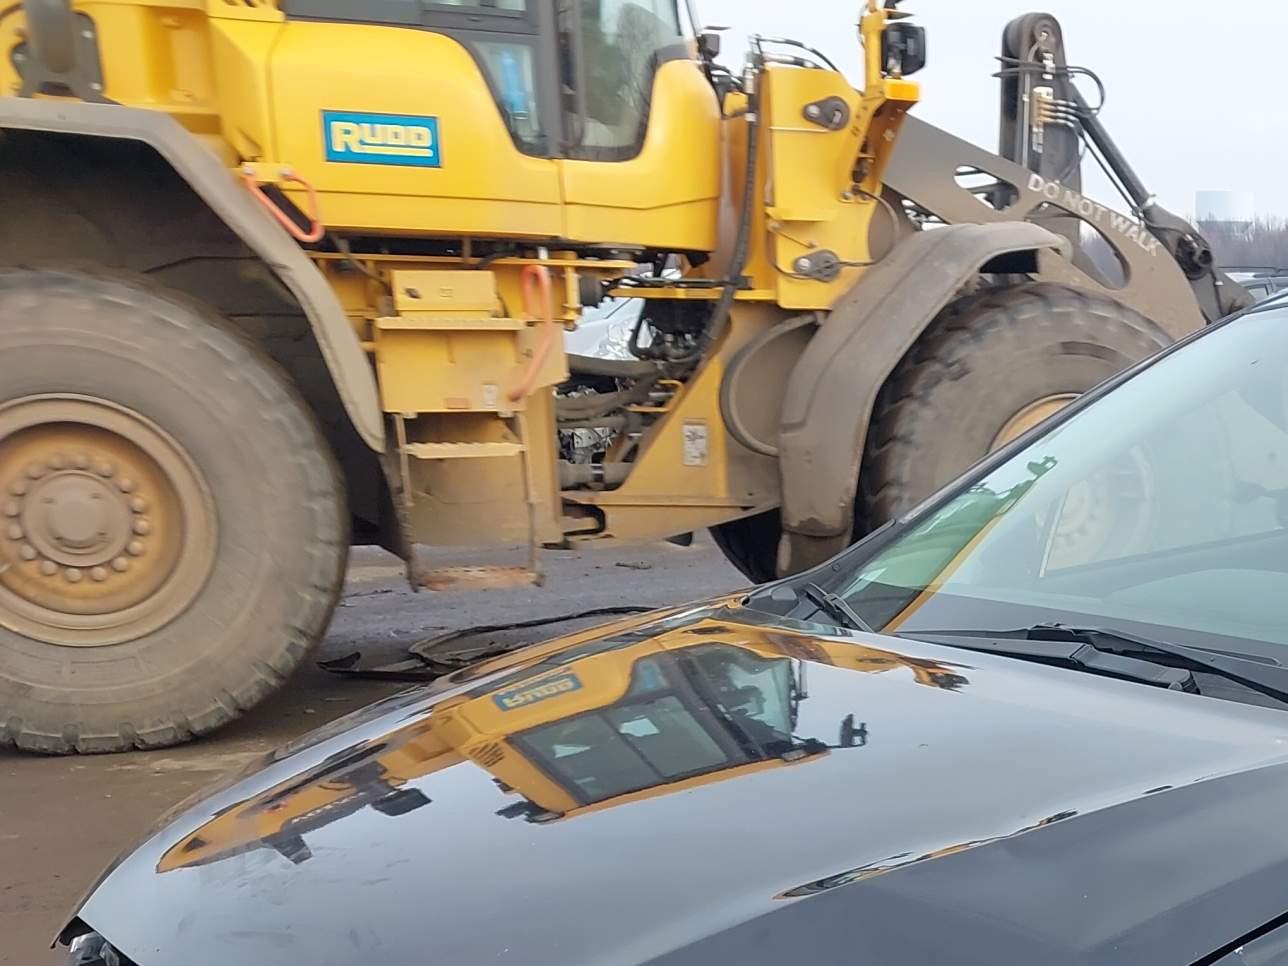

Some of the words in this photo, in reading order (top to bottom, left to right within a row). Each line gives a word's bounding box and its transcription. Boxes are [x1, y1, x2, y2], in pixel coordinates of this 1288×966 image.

[330, 121, 433, 156] RUDD
[1027, 173, 1060, 199] DO
[1063, 190, 1108, 223] NOT
[1109, 211, 1161, 257] WALK
